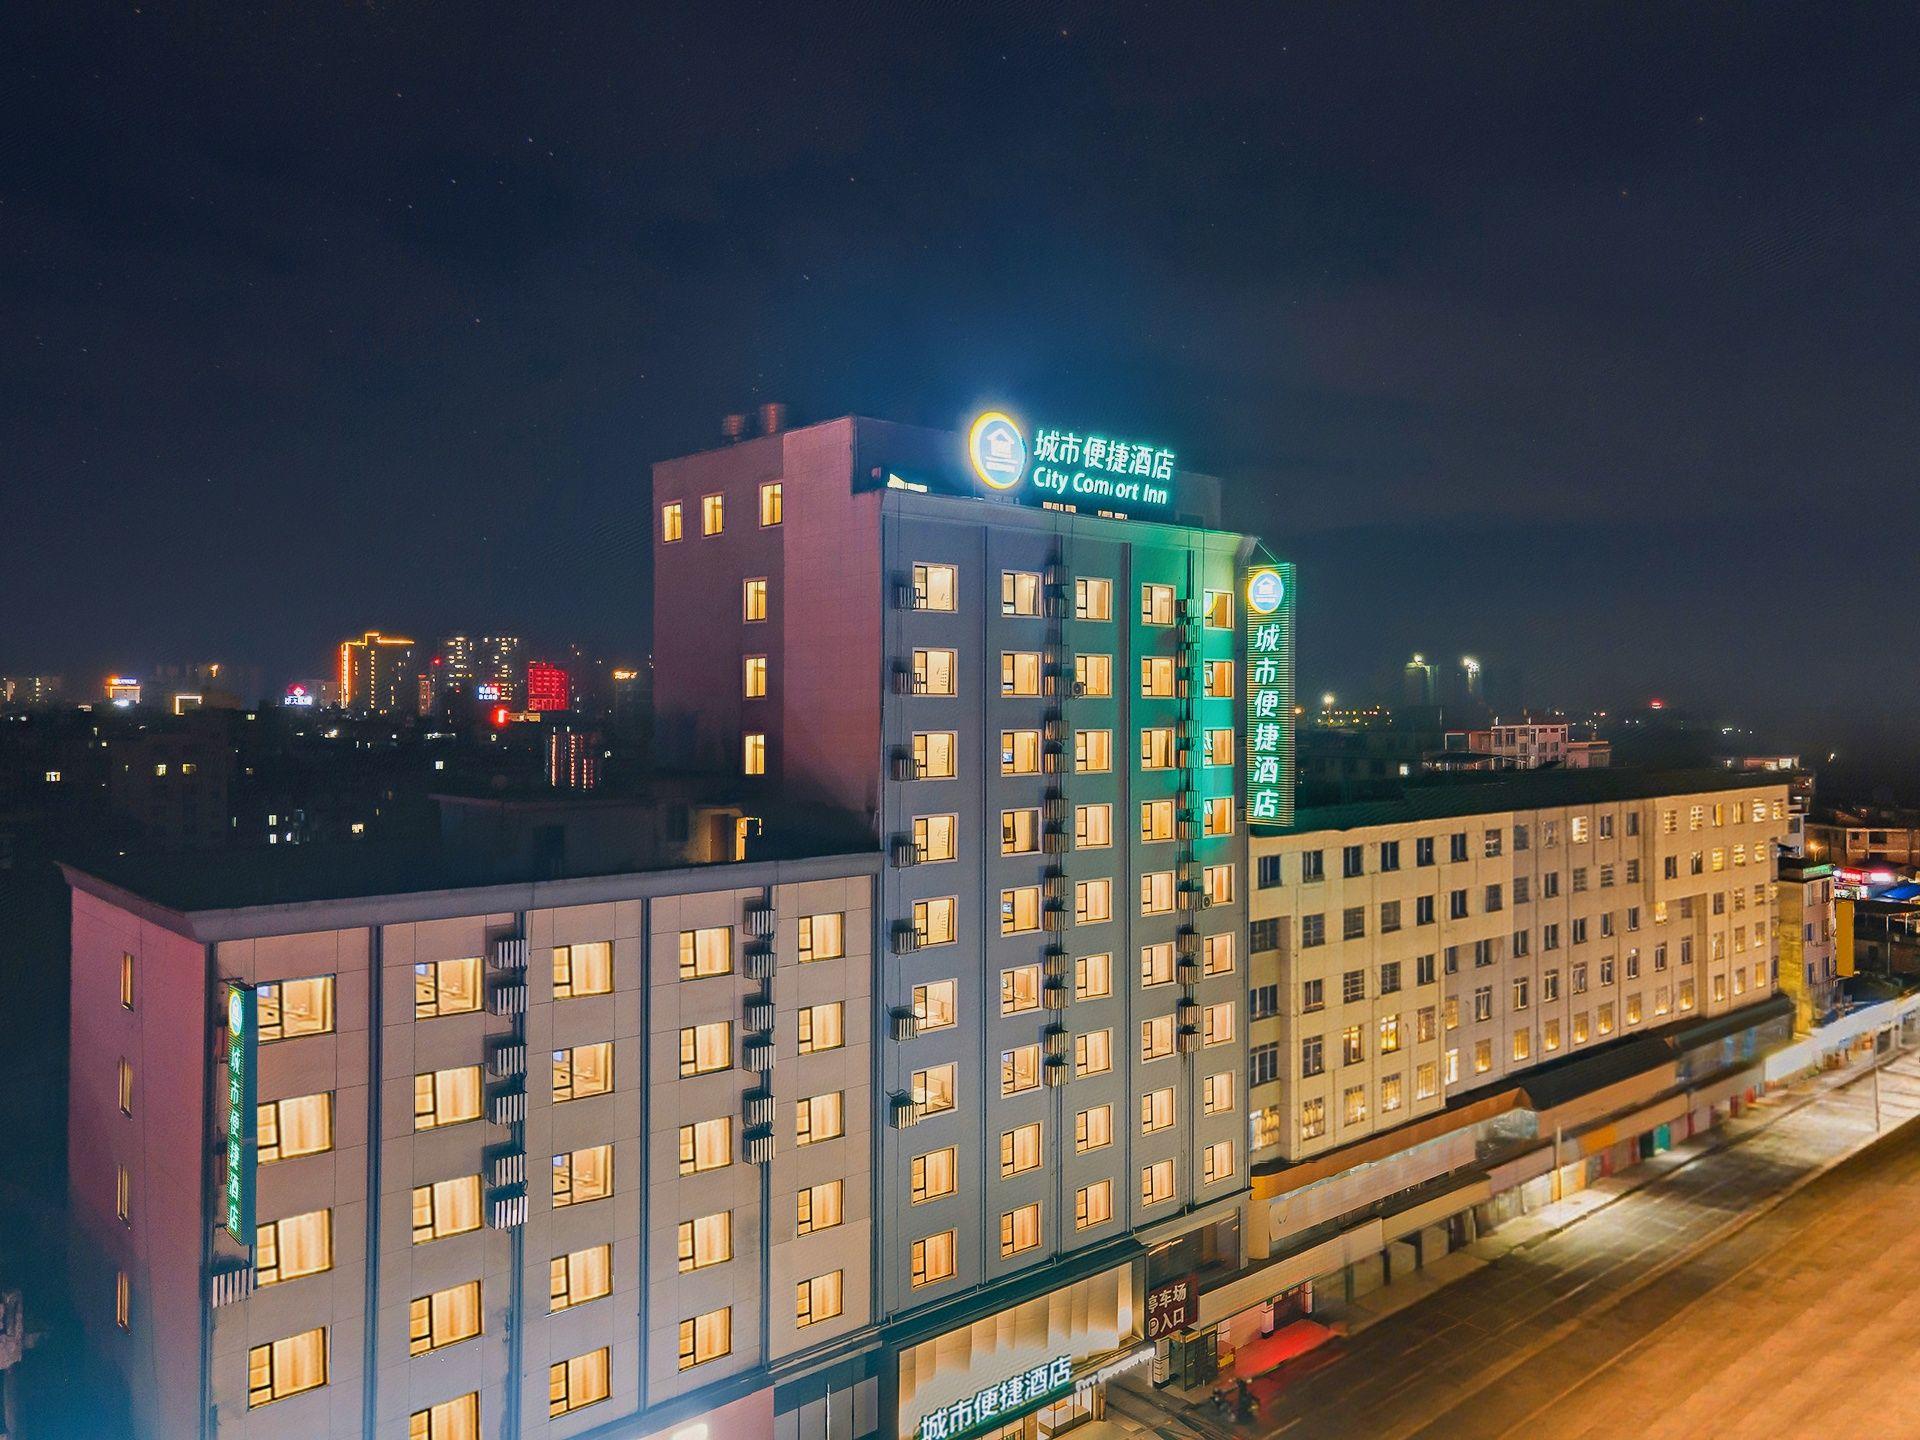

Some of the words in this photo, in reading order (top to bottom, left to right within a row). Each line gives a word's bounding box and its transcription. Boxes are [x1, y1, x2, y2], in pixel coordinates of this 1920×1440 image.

[1033, 466, 1069, 495] City
[1143, 483, 1168, 505] Inn
[1034, 429, 1175, 481] 城市便捷酒店
[1252, 623, 1281, 819] 城市便捷酒店
[920, 1355, 1073, 1440] 城市便捷酒店
